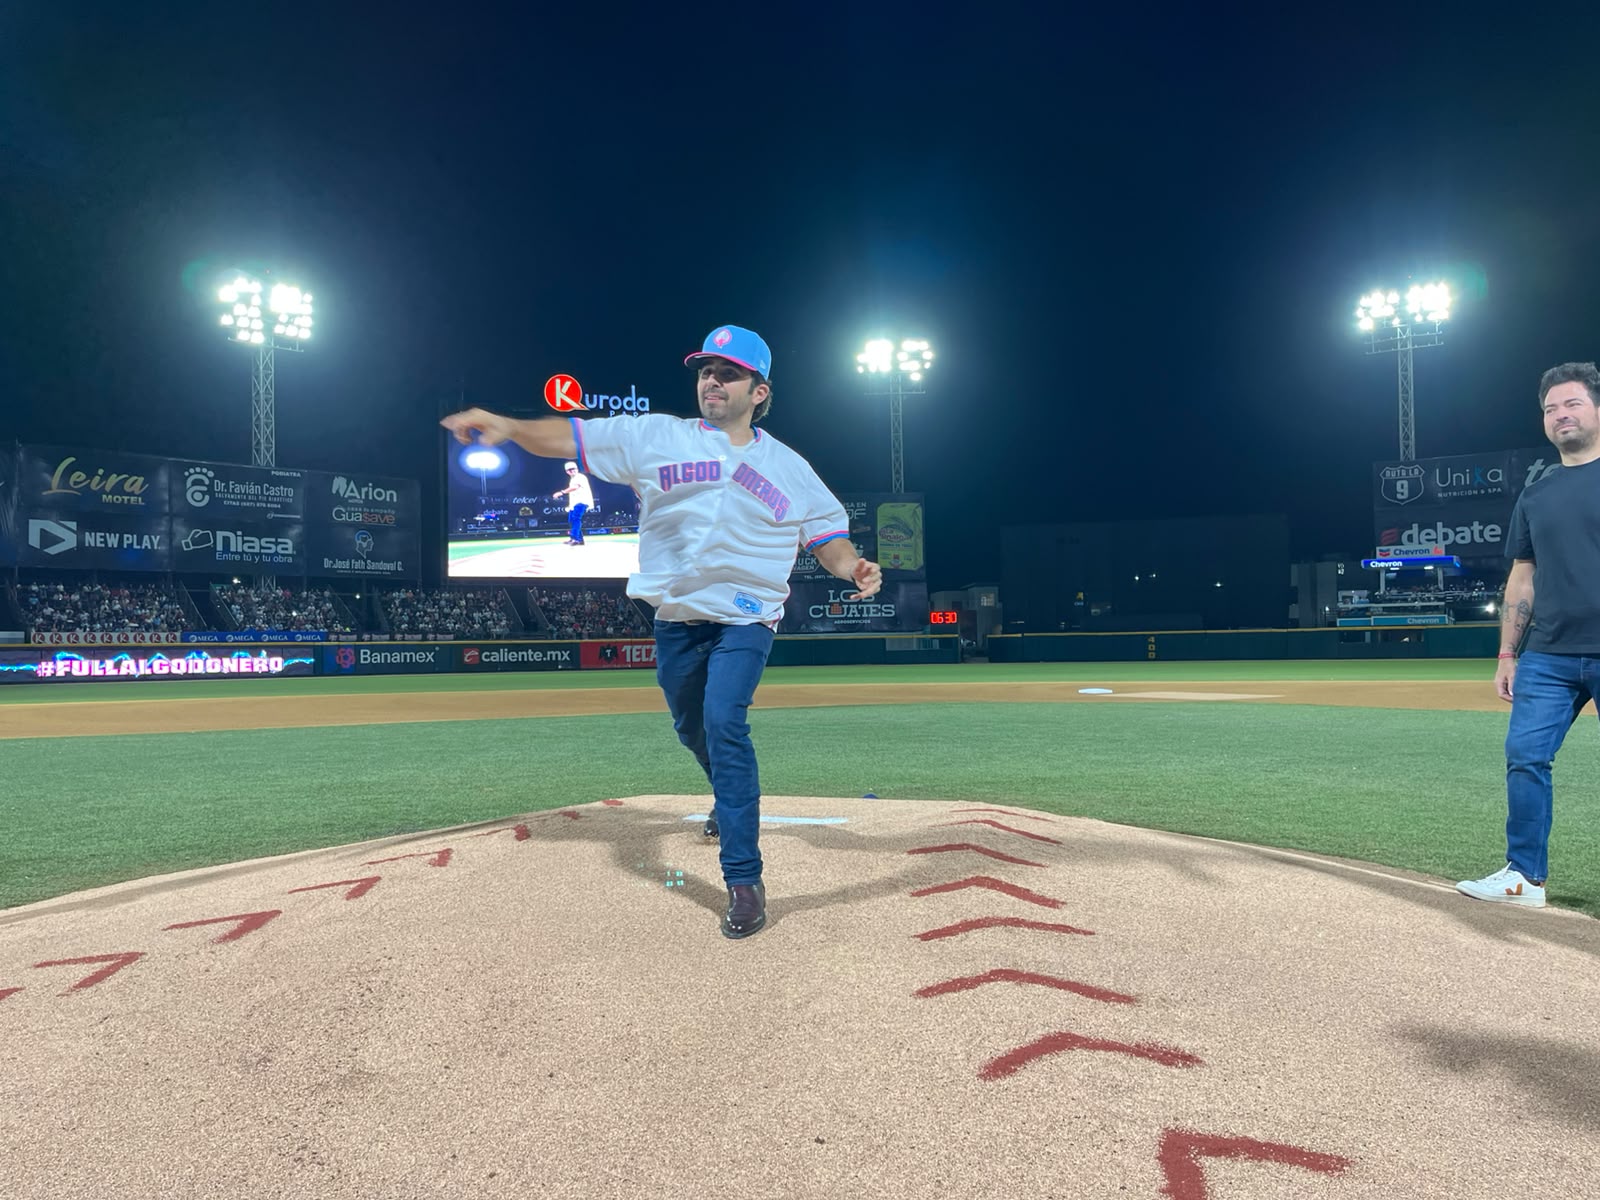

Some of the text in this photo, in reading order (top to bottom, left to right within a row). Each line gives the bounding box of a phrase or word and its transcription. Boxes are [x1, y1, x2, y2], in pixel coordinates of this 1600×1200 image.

[555, 378, 650, 412] Kuroda
[42, 456, 148, 496] Leira
[658, 460, 721, 492] ALGOD
[214, 480, 294, 497] Dr. Favián Castro
[344, 480, 397, 502] Arion
[732, 462, 790, 522] ONEROS
[1396, 480, 1408, 499] 9
[102, 494, 146, 505] MOTEL
[332, 507, 395, 524] Guasave
[85, 532, 160, 550] NEW PLAY
[1402, 521, 1501, 545] debate
[216, 552, 240, 560] Entre
[254, 554, 261, 563] y
[273, 554, 292, 562] obra
[1394, 547, 1430, 556] Chevron
[809, 604, 895, 618] CUATES
[360, 650, 434, 664] Banamex
[482, 649, 570, 662] caliente.mx
[622, 645, 656, 662] TECA
[36, 656, 283, 676] #FULLALGODONERO
